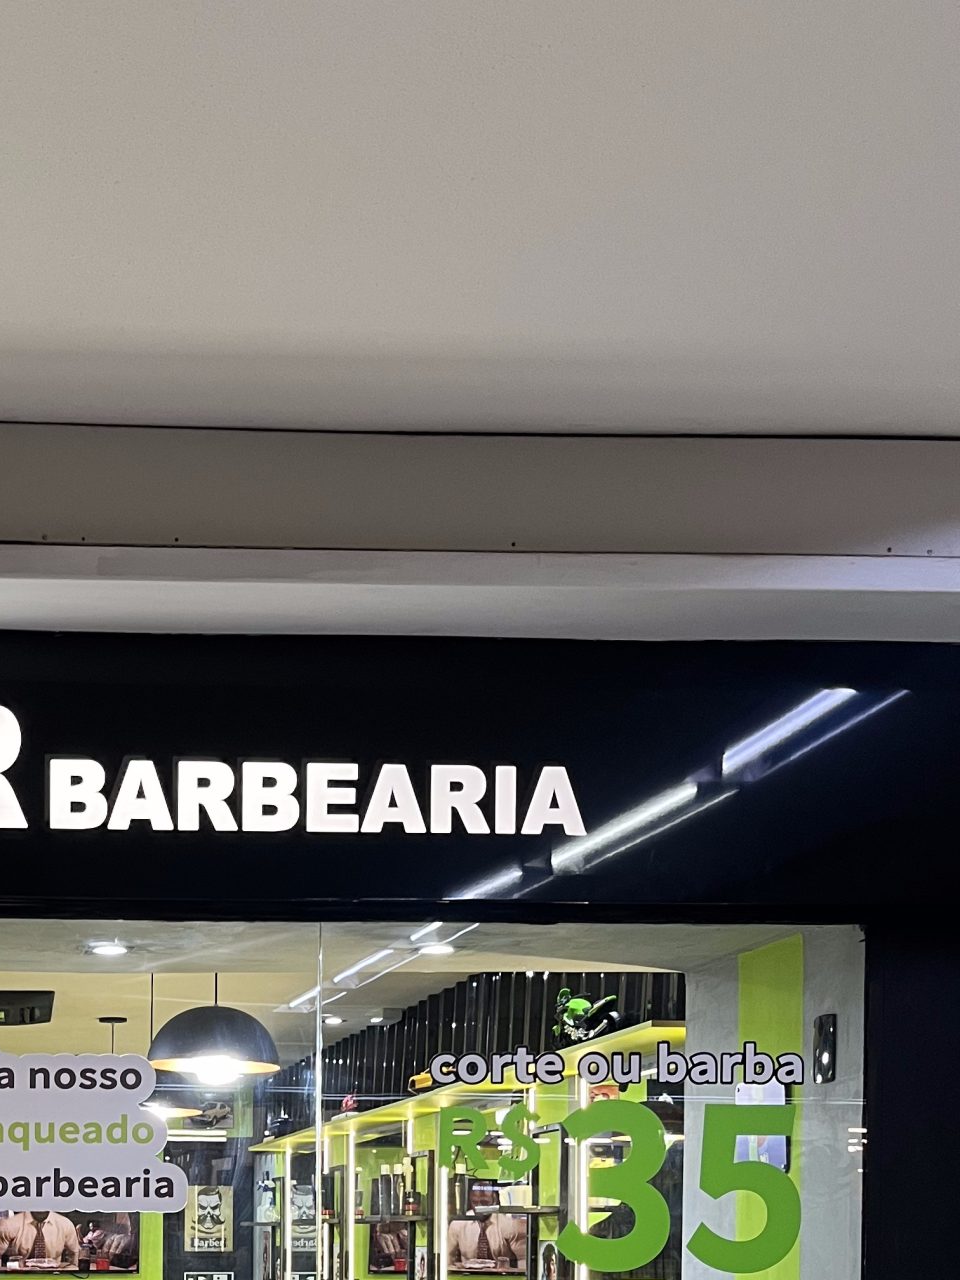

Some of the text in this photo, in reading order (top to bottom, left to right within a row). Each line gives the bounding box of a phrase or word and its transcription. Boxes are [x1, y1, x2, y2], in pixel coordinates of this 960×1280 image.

[49, 757, 587, 836] BARBEARIA
[28, 1065, 143, 1090] nosso
[430, 1041, 804, 1085] corte ou barba
